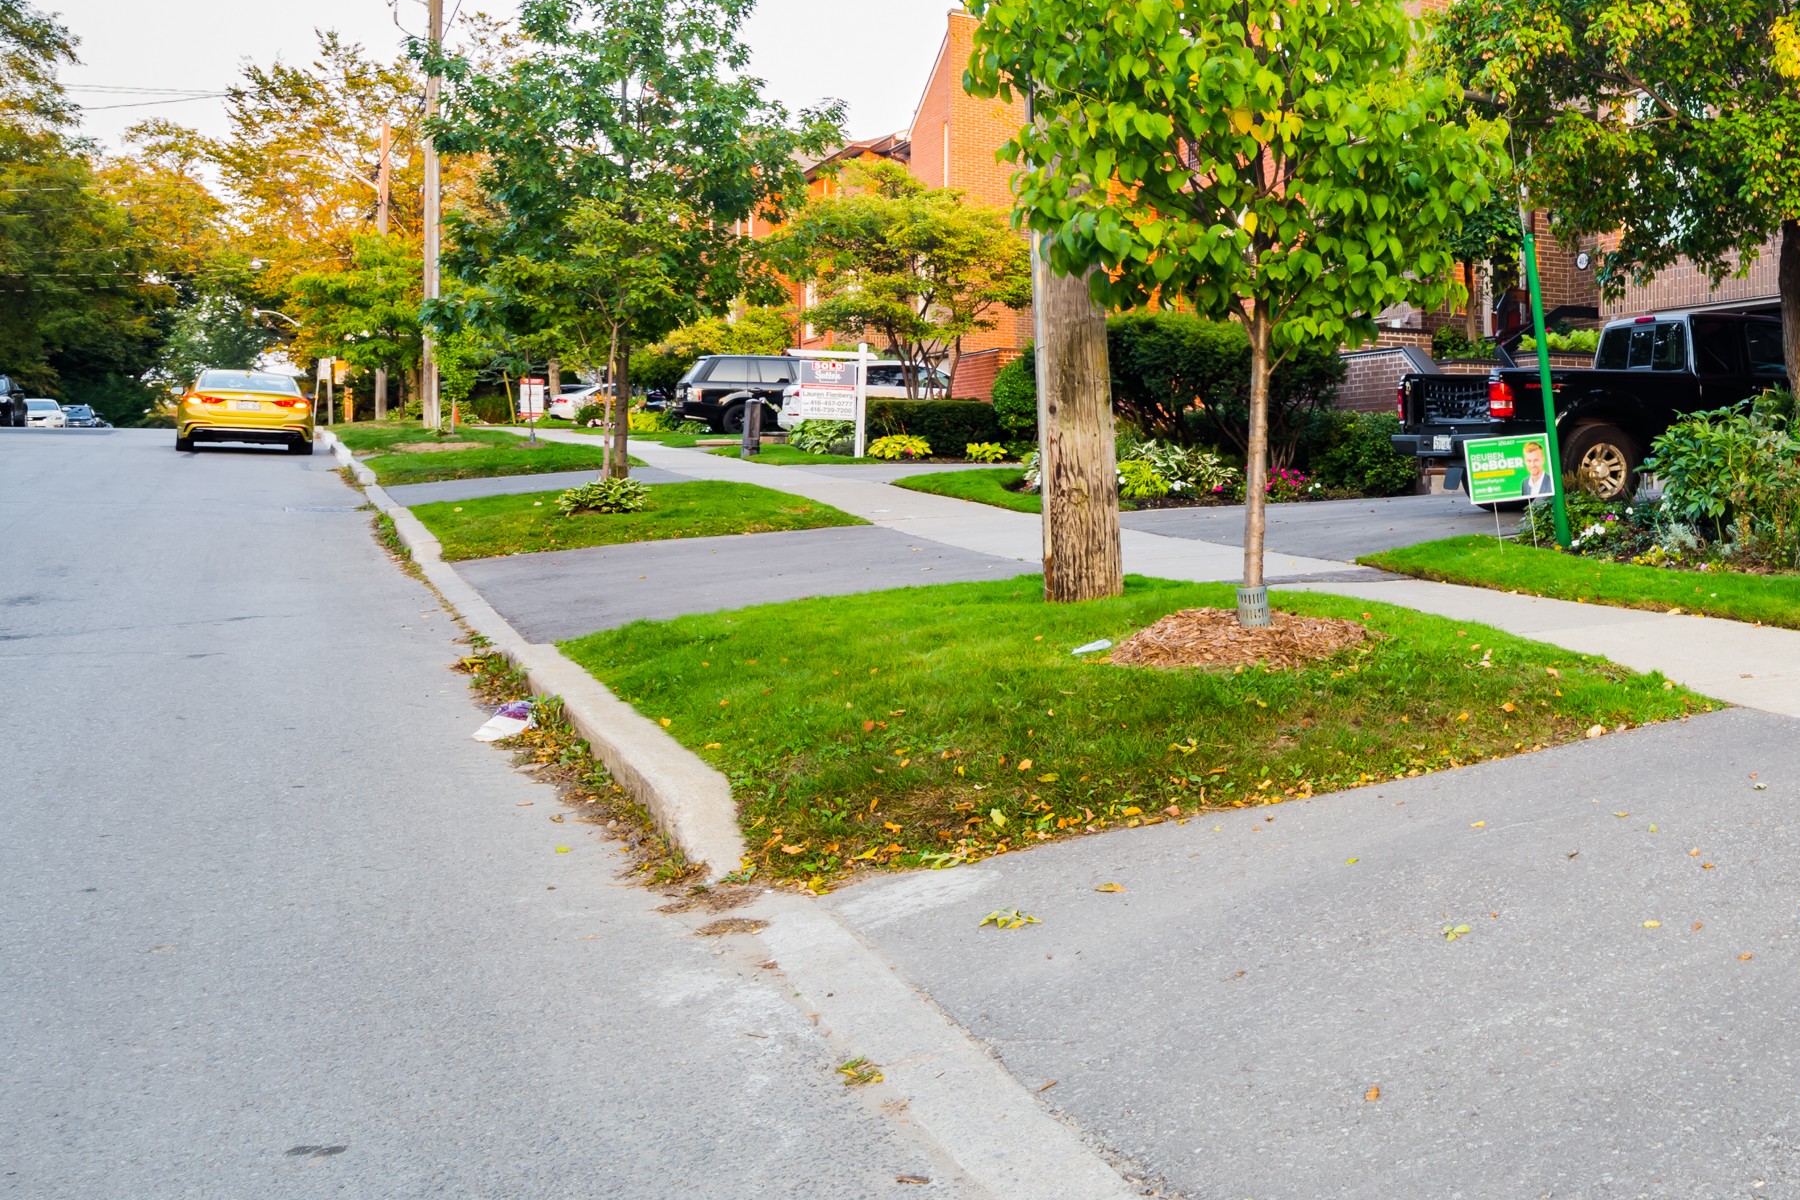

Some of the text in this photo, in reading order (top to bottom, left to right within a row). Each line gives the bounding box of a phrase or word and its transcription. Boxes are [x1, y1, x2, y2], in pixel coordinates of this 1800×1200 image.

[814, 362, 842, 370] SOLD
[814, 370, 842, 380] Sutton
[1470, 452, 1504, 462] REUBEN
[1471, 457, 1524, 472] DeBOER
